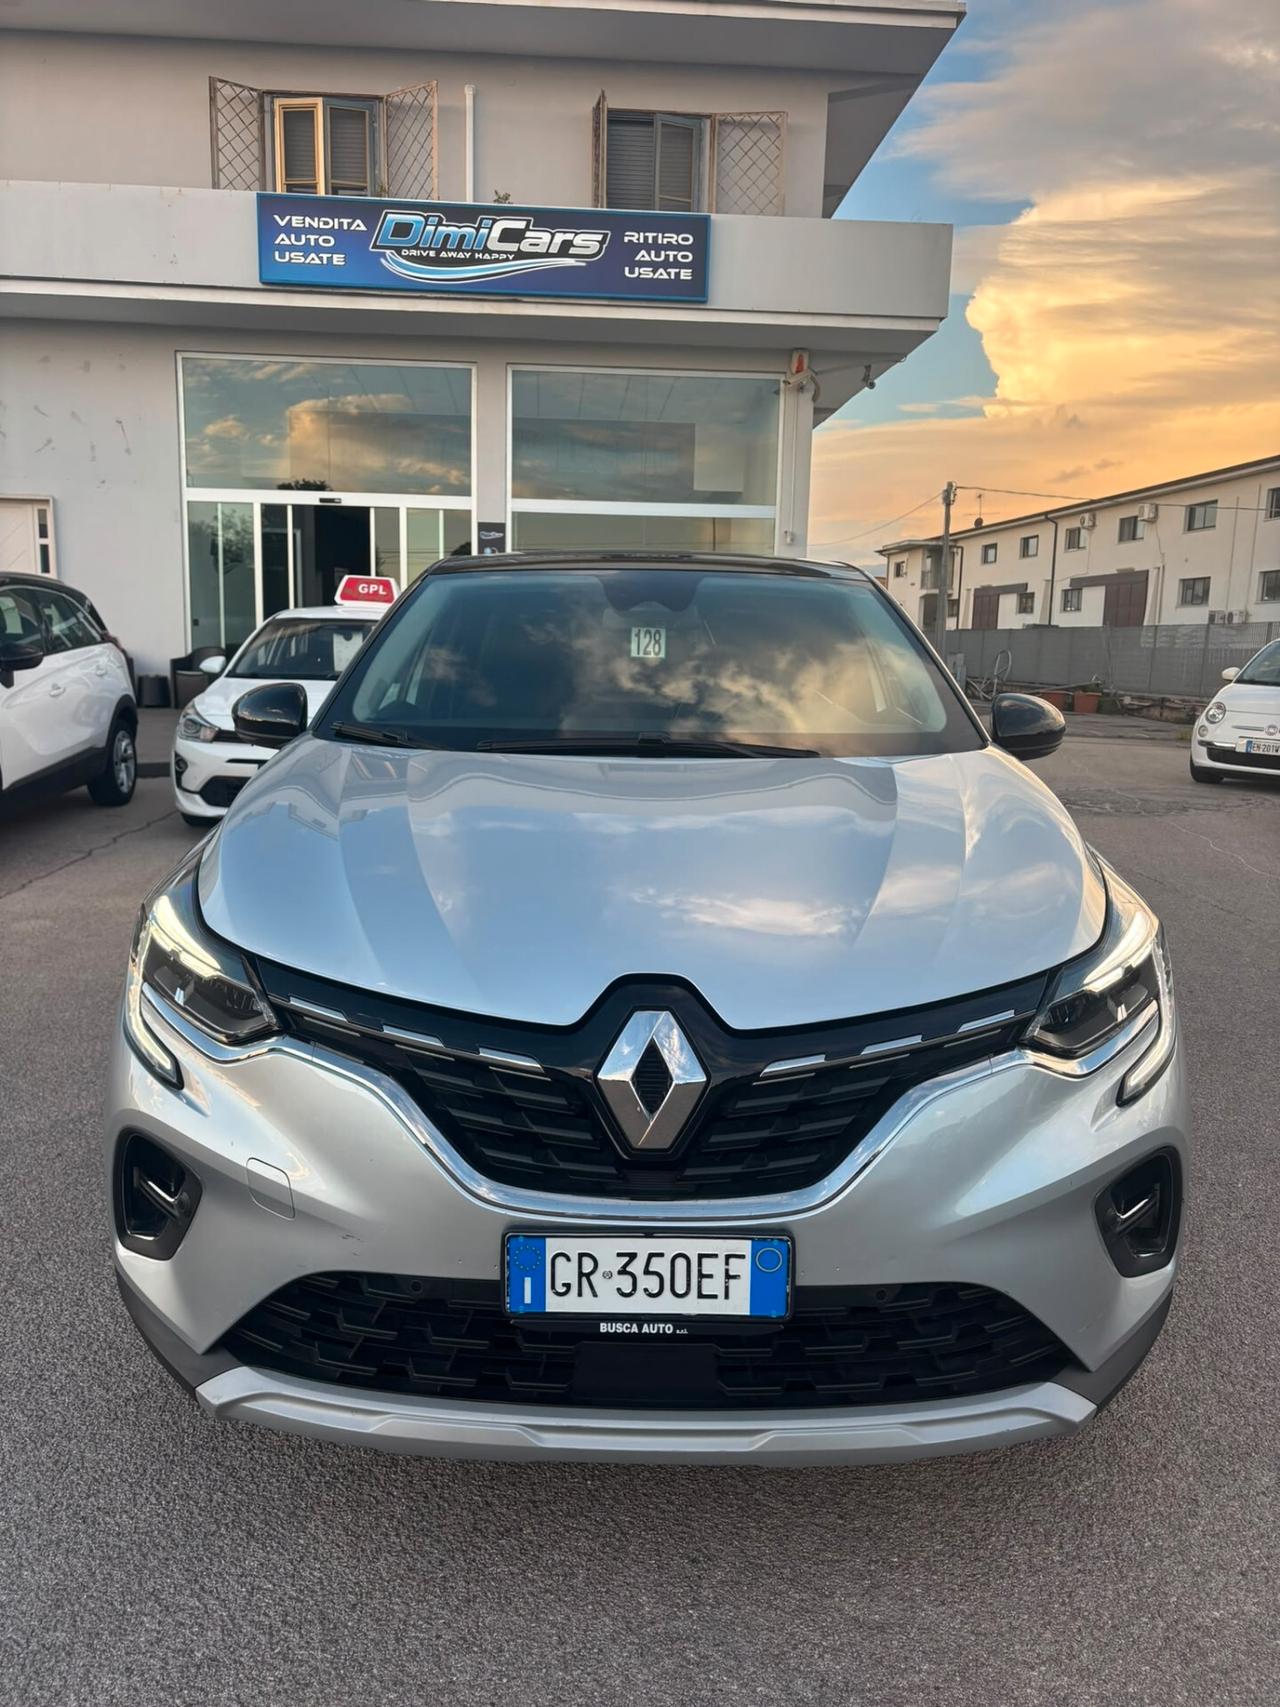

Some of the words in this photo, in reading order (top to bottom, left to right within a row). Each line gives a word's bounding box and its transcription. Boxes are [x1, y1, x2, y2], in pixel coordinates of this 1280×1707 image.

[273, 214, 368, 231] VENDITA
[274, 233, 335, 247] AUTO
[376, 213, 604, 256] DimiCars
[623, 231, 694, 246] RITIRO
[274, 251, 346, 266] USATE
[401, 249, 436, 258] DRIVE
[439, 251, 471, 260] AWAY
[475, 252, 516, 261] HAPPY
[634, 249, 693, 263] AUTO
[624, 266, 692, 280] USATE
[358, 583, 388, 596] GPL
[634, 628, 662, 657] 128
[600, 1322, 639, 1333] BUSCA
[641, 1323, 674, 1334] AUTO
